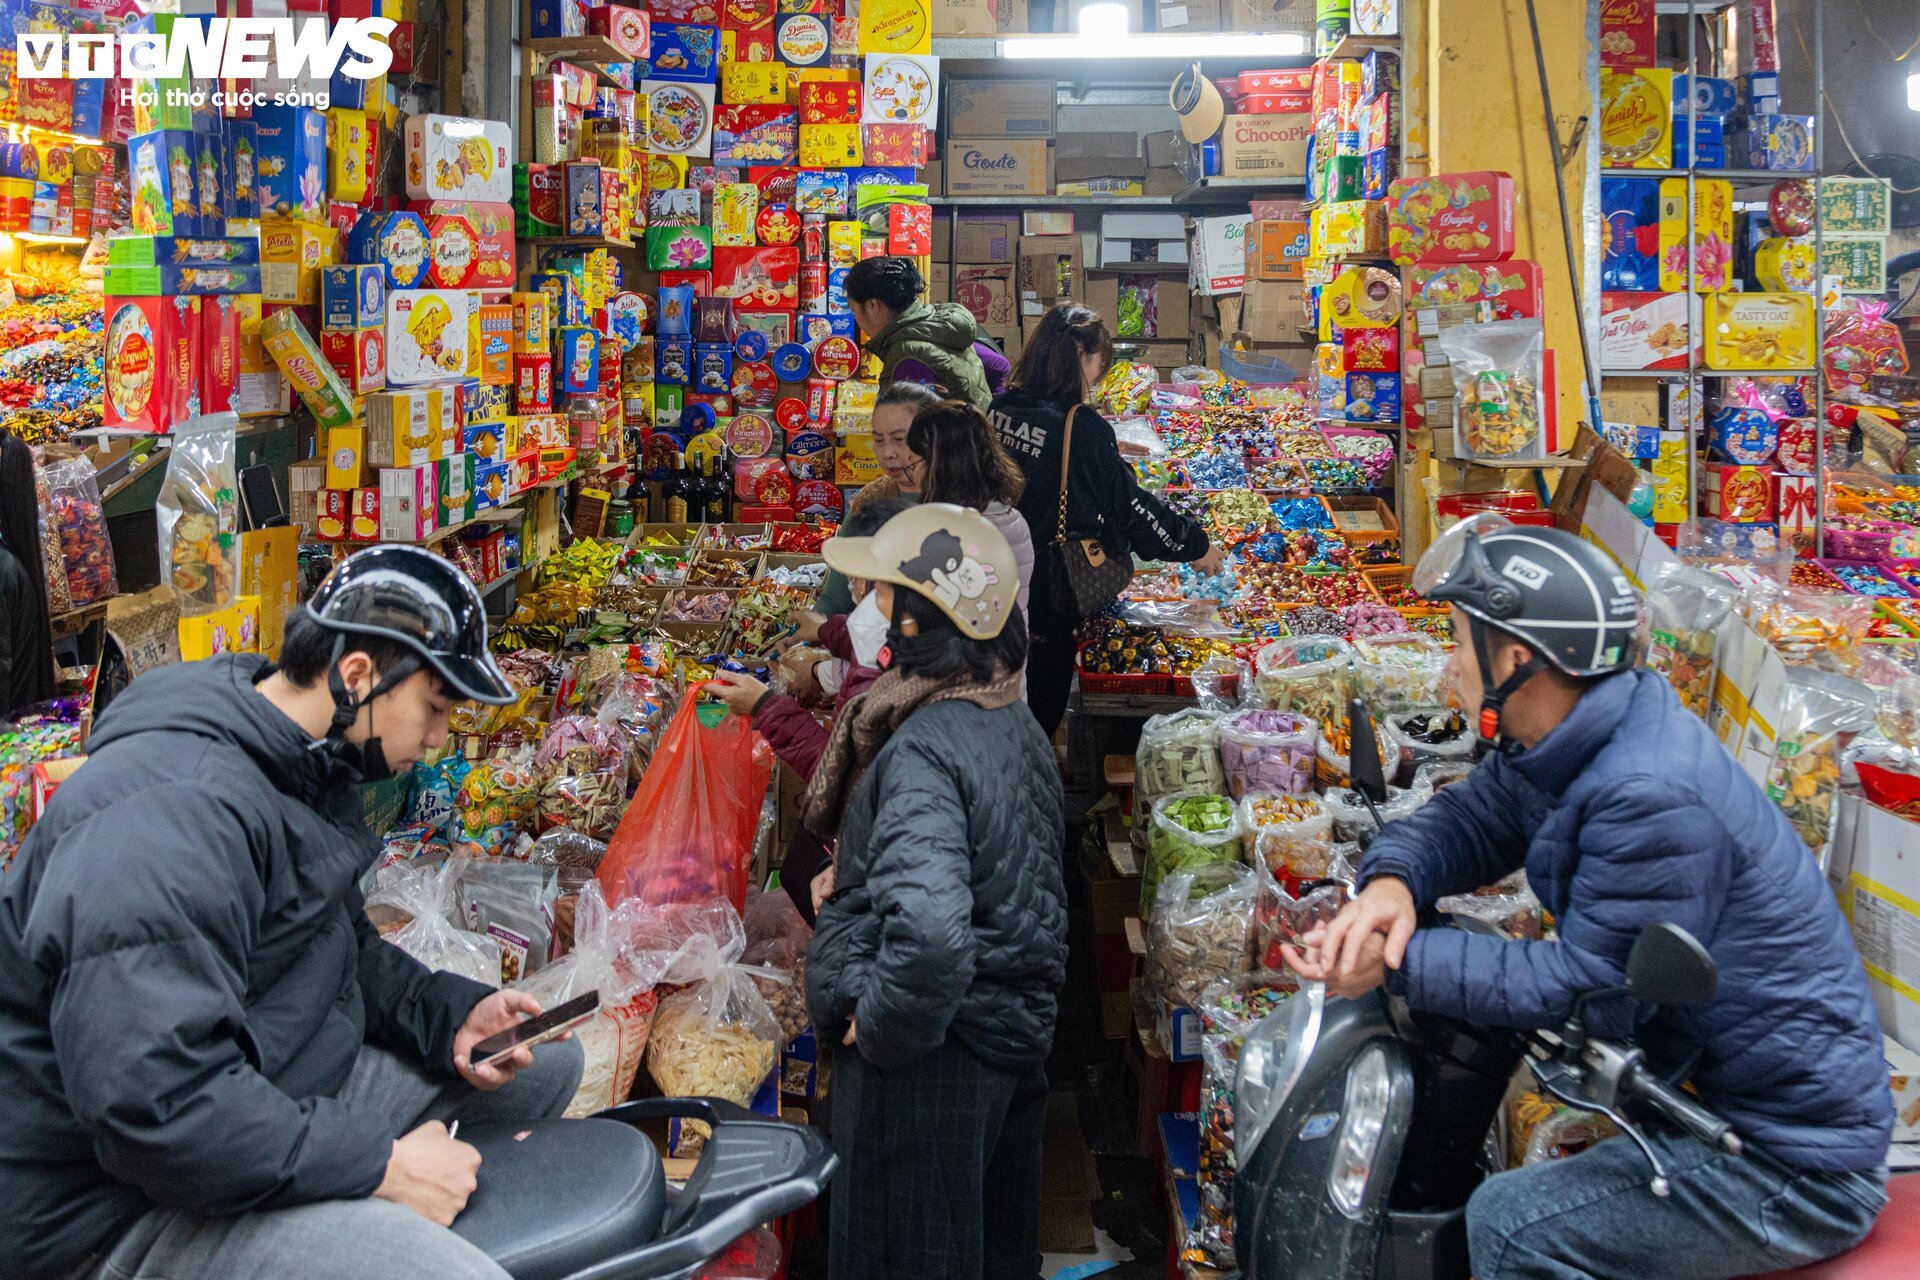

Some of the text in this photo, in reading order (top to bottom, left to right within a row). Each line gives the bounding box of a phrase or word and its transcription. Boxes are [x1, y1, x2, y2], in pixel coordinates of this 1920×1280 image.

[785, 22, 818, 37] Danisa
[873, 11, 915, 33] Kingwell
[33, 84, 57, 94] ROYAL
[745, 115, 768, 123] ROYAL
[1439, 213, 1475, 228] Dragon
[266, 233, 296, 252] Atela
[478, 240, 501, 255] Dragon
[1735, 311, 1790, 321] TASTY OAT
[1621, 319, 1648, 338] Milk
[485, 343, 510, 356] Cheese
[491, 336, 503, 346] Cal
[119, 348, 149, 368] Kingwell
[178, 337, 190, 390] Kingwell
[221, 335, 232, 387] Kingwell
[822, 351, 852, 360] Kingwell
[286, 356, 319, 389] Solite
[988, 409, 1047, 448] ATLAS
[791, 438, 827, 452] Gilmore
[996, 432, 1041, 458] EMIER
[330, 492, 339, 514] COSY
[365, 492, 374, 514] COSY
